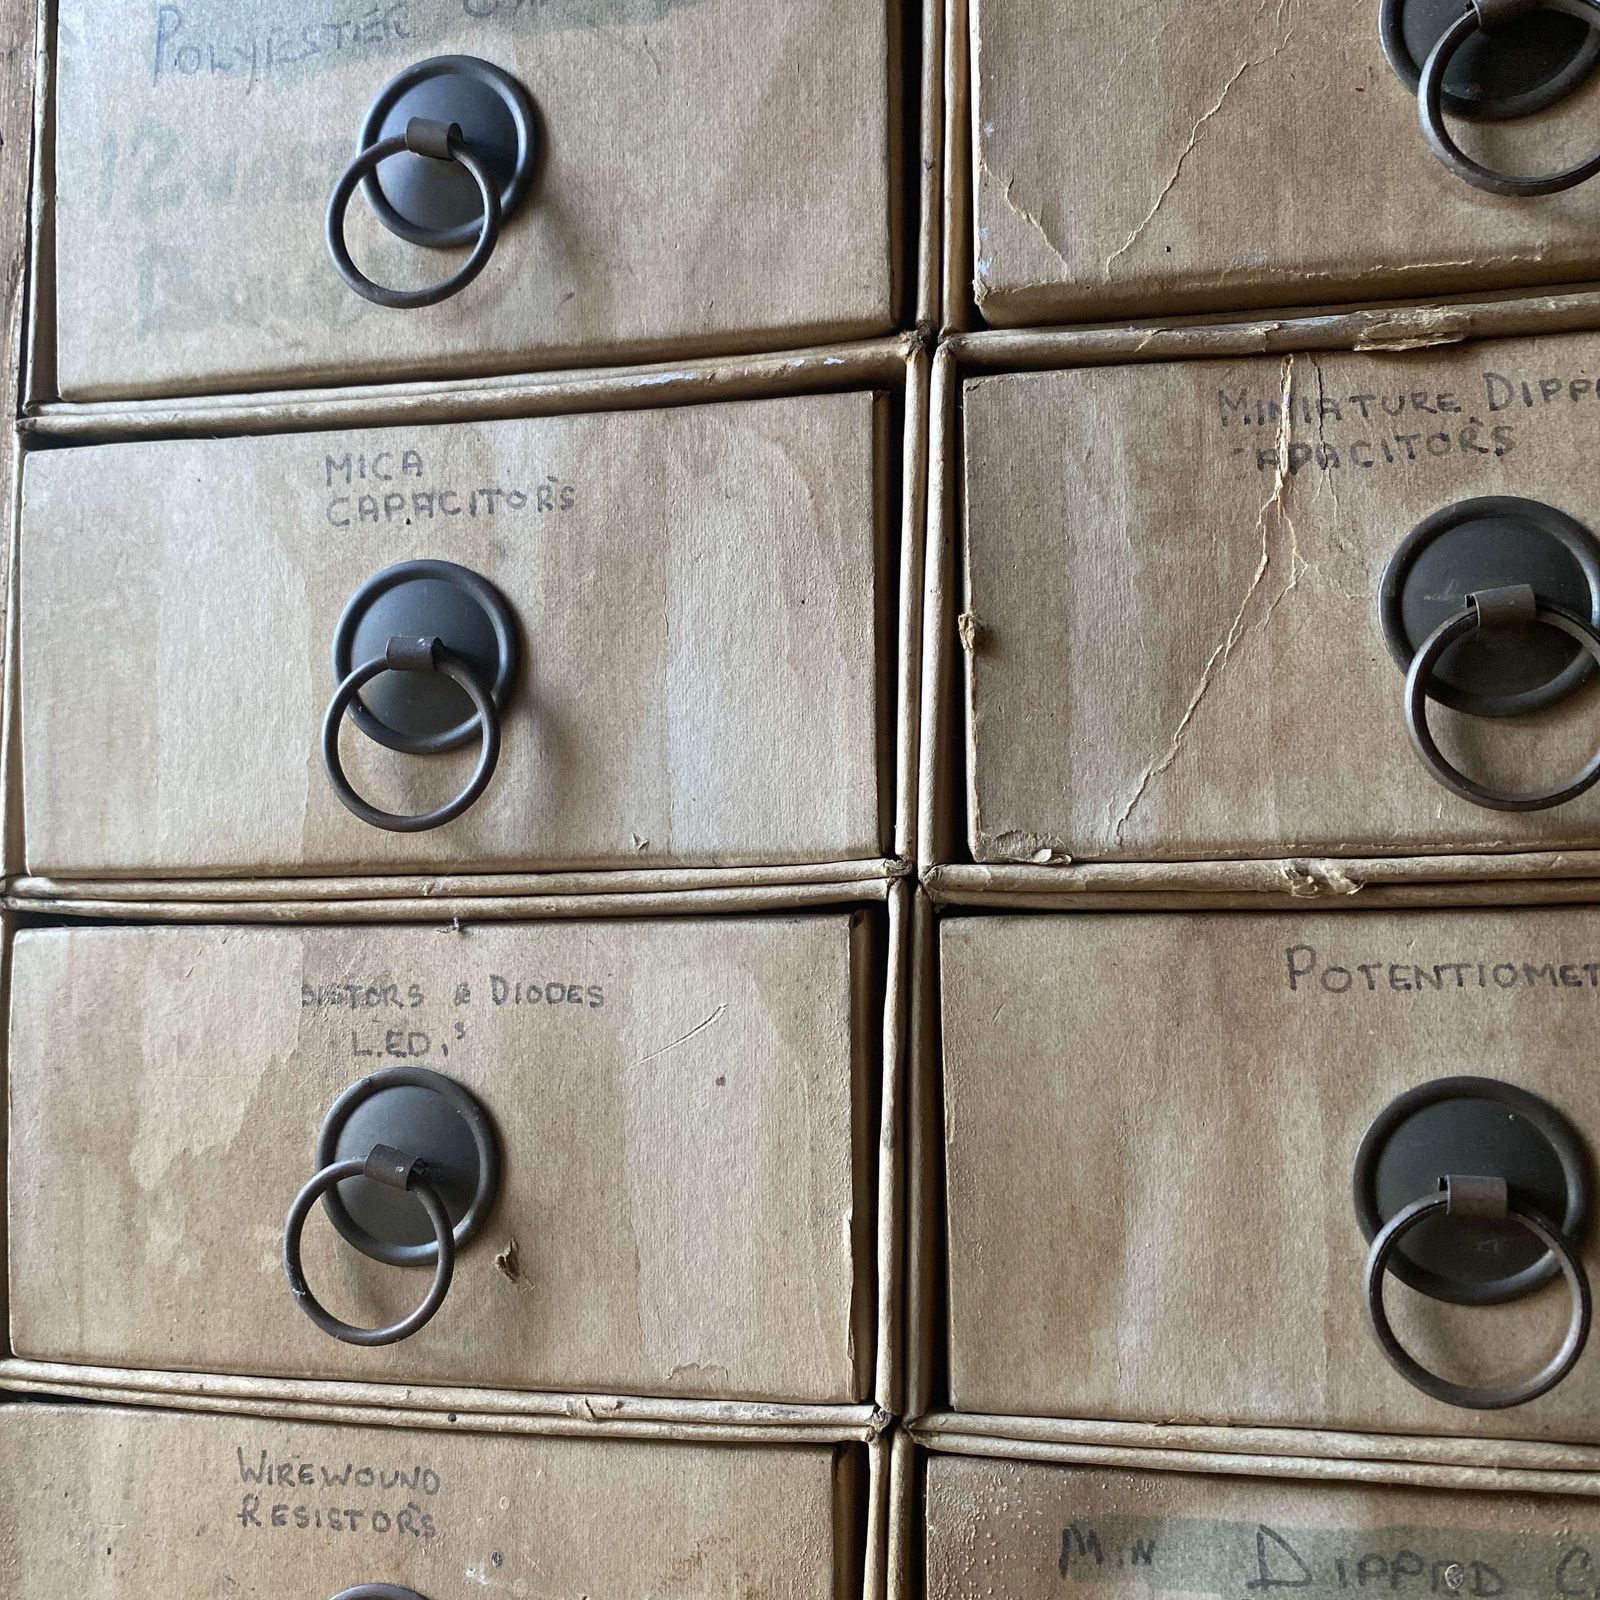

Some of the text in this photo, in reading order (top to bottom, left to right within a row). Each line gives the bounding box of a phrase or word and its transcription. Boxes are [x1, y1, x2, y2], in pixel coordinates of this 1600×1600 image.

[1482, 372, 1600, 412] DIPP
[325, 450, 424, 488] MICA
[1286, 944, 1600, 993] POTENTIOMET
[489, 974, 605, 1009] DIODES
[237, 1446, 440, 1495] WIREWOUND
